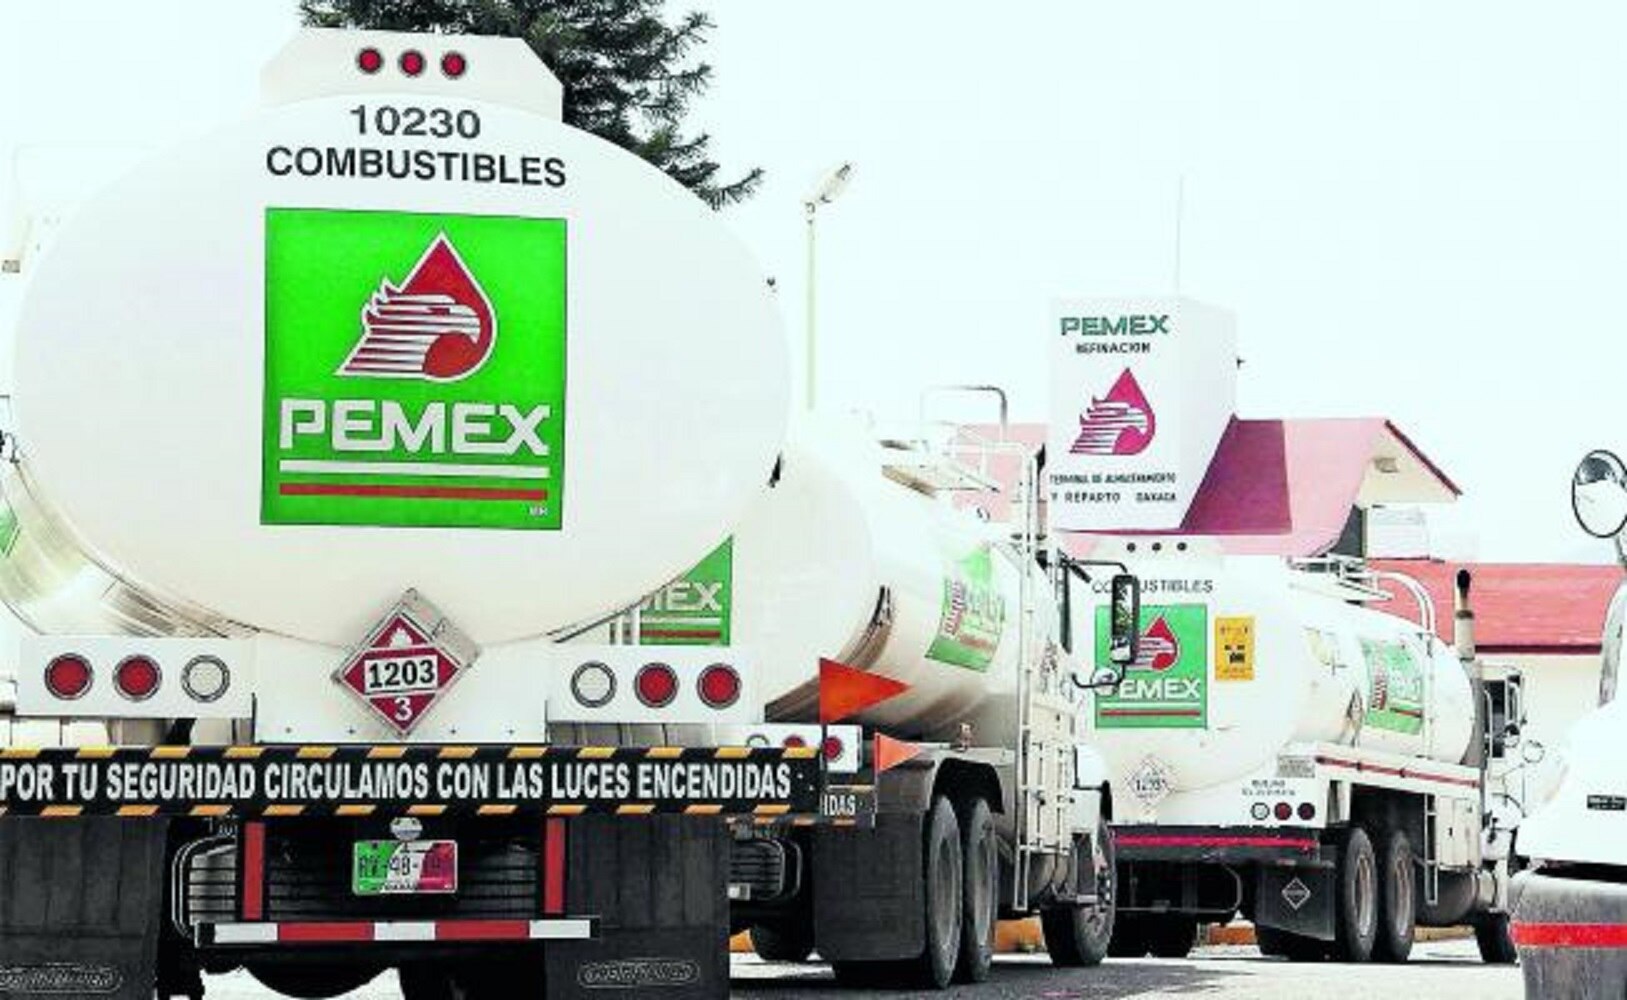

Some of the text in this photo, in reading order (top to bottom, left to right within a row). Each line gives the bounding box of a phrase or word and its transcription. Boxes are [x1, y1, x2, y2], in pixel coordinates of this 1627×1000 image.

[350, 105, 481, 139] 10230
[266, 146, 567, 188] COMBUSTIBLES
[1060, 315, 1169, 336] PEMEX
[279, 398, 551, 456] PEMEX
[1092, 579, 1214, 594] COUSTIBLES
[369, 659, 434, 688] 1203
[1119, 679, 1201, 699] EMEX
[394, 697, 413, 721] 3
[0, 762, 791, 800] POR TU SEGURIDAD CIRCULAMOS CON LAS LUCES ENCENDIDAS
